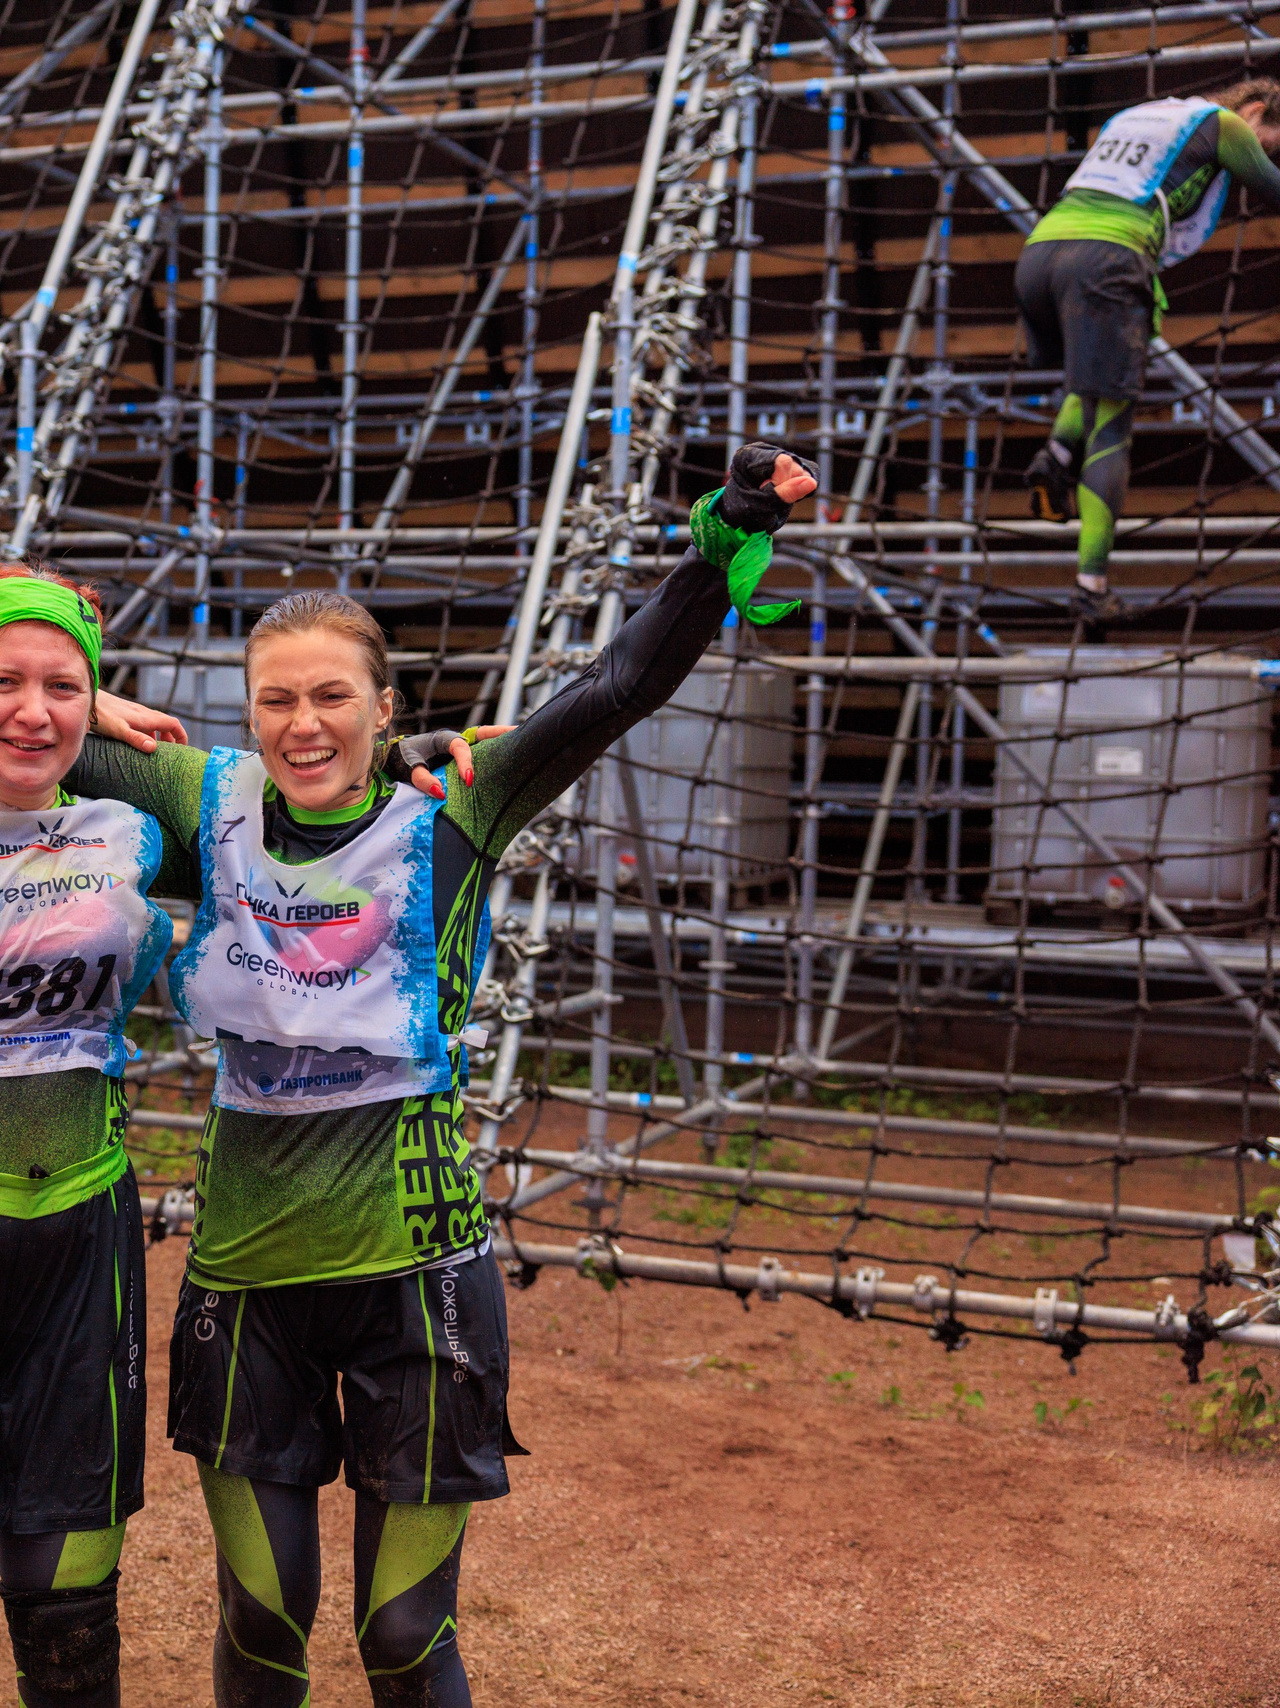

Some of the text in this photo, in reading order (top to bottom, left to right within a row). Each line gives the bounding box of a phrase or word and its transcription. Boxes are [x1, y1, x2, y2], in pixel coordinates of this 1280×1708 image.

[17, 895, 79, 914] GLOBAL
[286, 901, 360, 921] ГЕРОЕВ
[226, 942, 350, 991] Greenway
[257, 978, 319, 1000] GLOBAL
[280, 1069, 363, 1090] ГАЗПРОМБАНК
